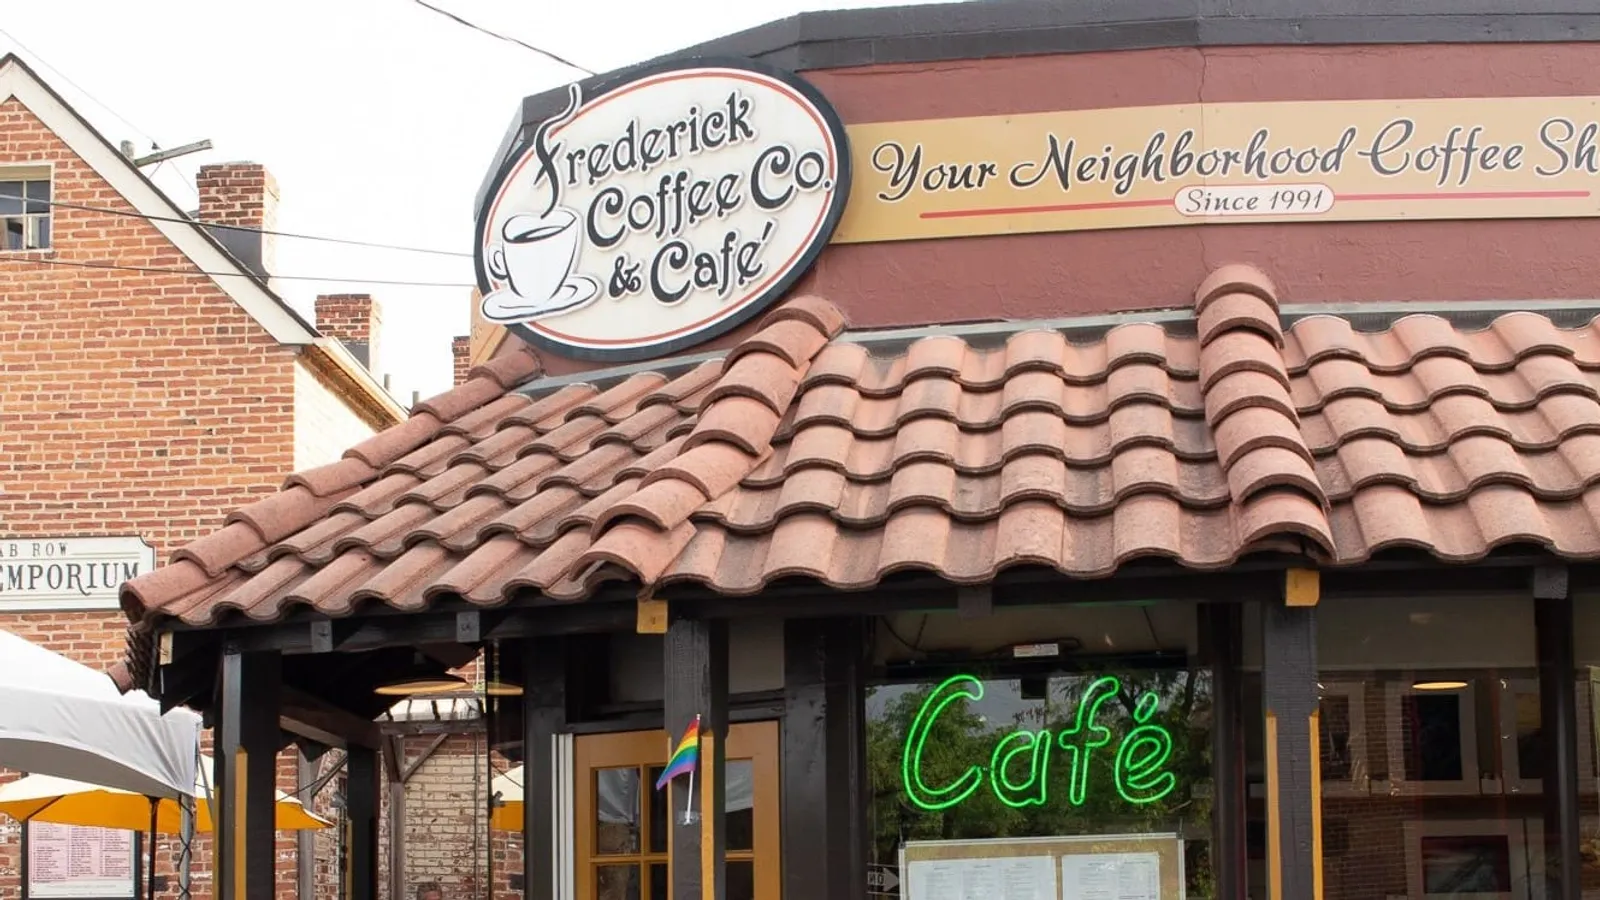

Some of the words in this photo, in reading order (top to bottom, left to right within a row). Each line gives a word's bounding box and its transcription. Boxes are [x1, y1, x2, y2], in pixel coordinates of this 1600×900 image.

[534, 92, 754, 220] Frederick
[872, 143, 997, 201] Your
[1010, 128, 1357, 195] Neighborhood
[1357, 119, 1524, 185] Coffee
[587, 171, 742, 248] Coffee
[751, 145, 832, 210] Co.
[1185, 188, 1259, 213] Since
[1270, 189, 1323, 210] 1991
[608, 256, 642, 299] &
[0, 562, 139, 596] MPORIUM
[32, 542, 68, 557] ROW
[902, 673, 1176, 811] Café
